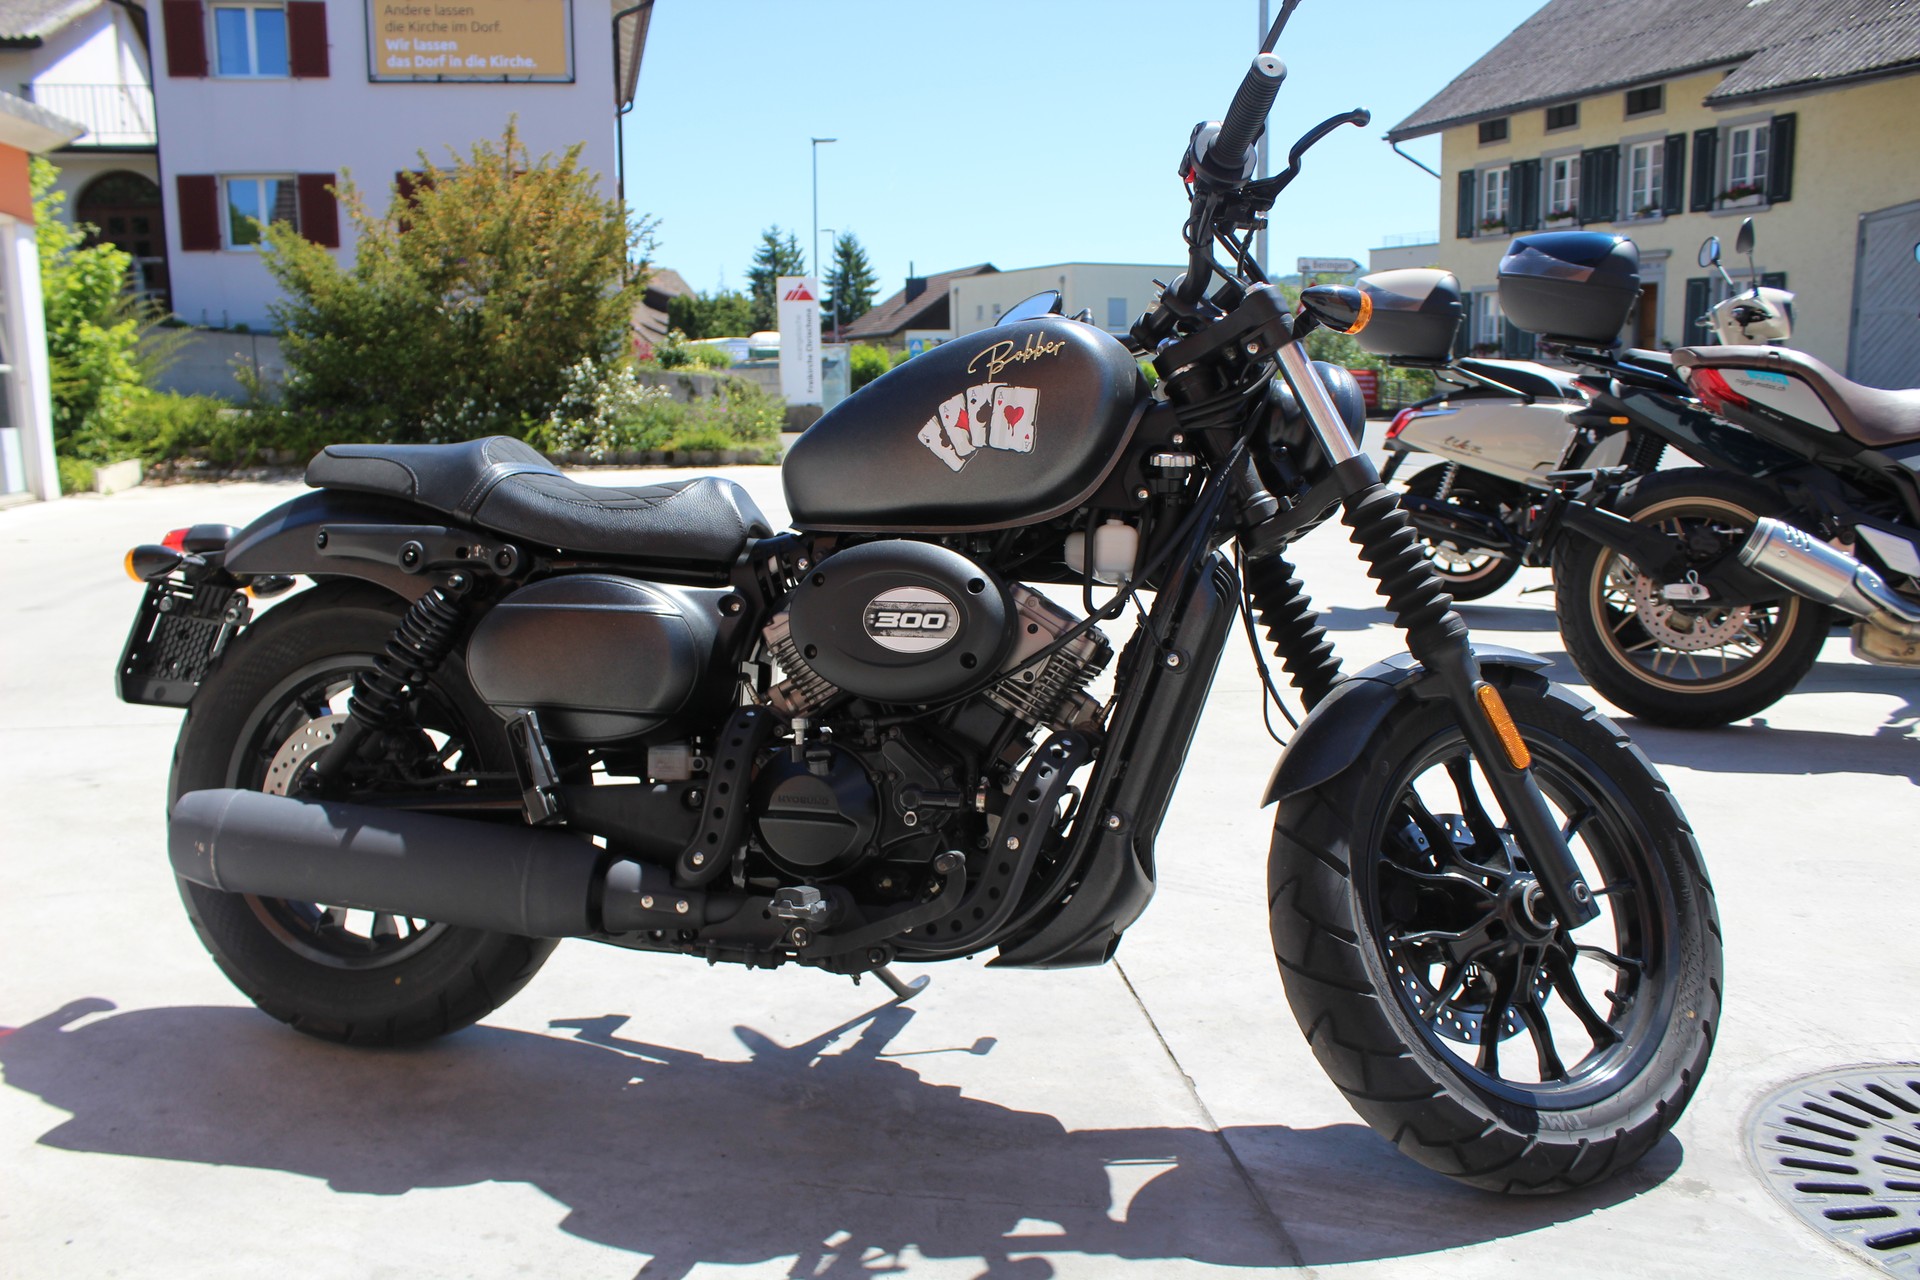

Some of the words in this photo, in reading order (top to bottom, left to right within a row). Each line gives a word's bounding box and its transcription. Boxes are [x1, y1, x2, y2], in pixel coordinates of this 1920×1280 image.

[384, 4, 431, 16] Andere
[434, 4, 474, 16] lassen
[385, 21, 404, 33] die
[408, 21, 448, 33] Kirche
[451, 21, 468, 33] im
[470, 21, 502, 33] Dorf.
[386, 38, 409, 50] Wir
[414, 38, 458, 50] lassen
[386, 55, 410, 68] das
[414, 55, 446, 68] Dorf
[449, 55, 463, 68] in
[465, 55, 487, 68] die
[490, 55, 538, 68] Kirche.
[968, 331, 1066, 382] Bobber
[875, 612, 946, 629] 300
